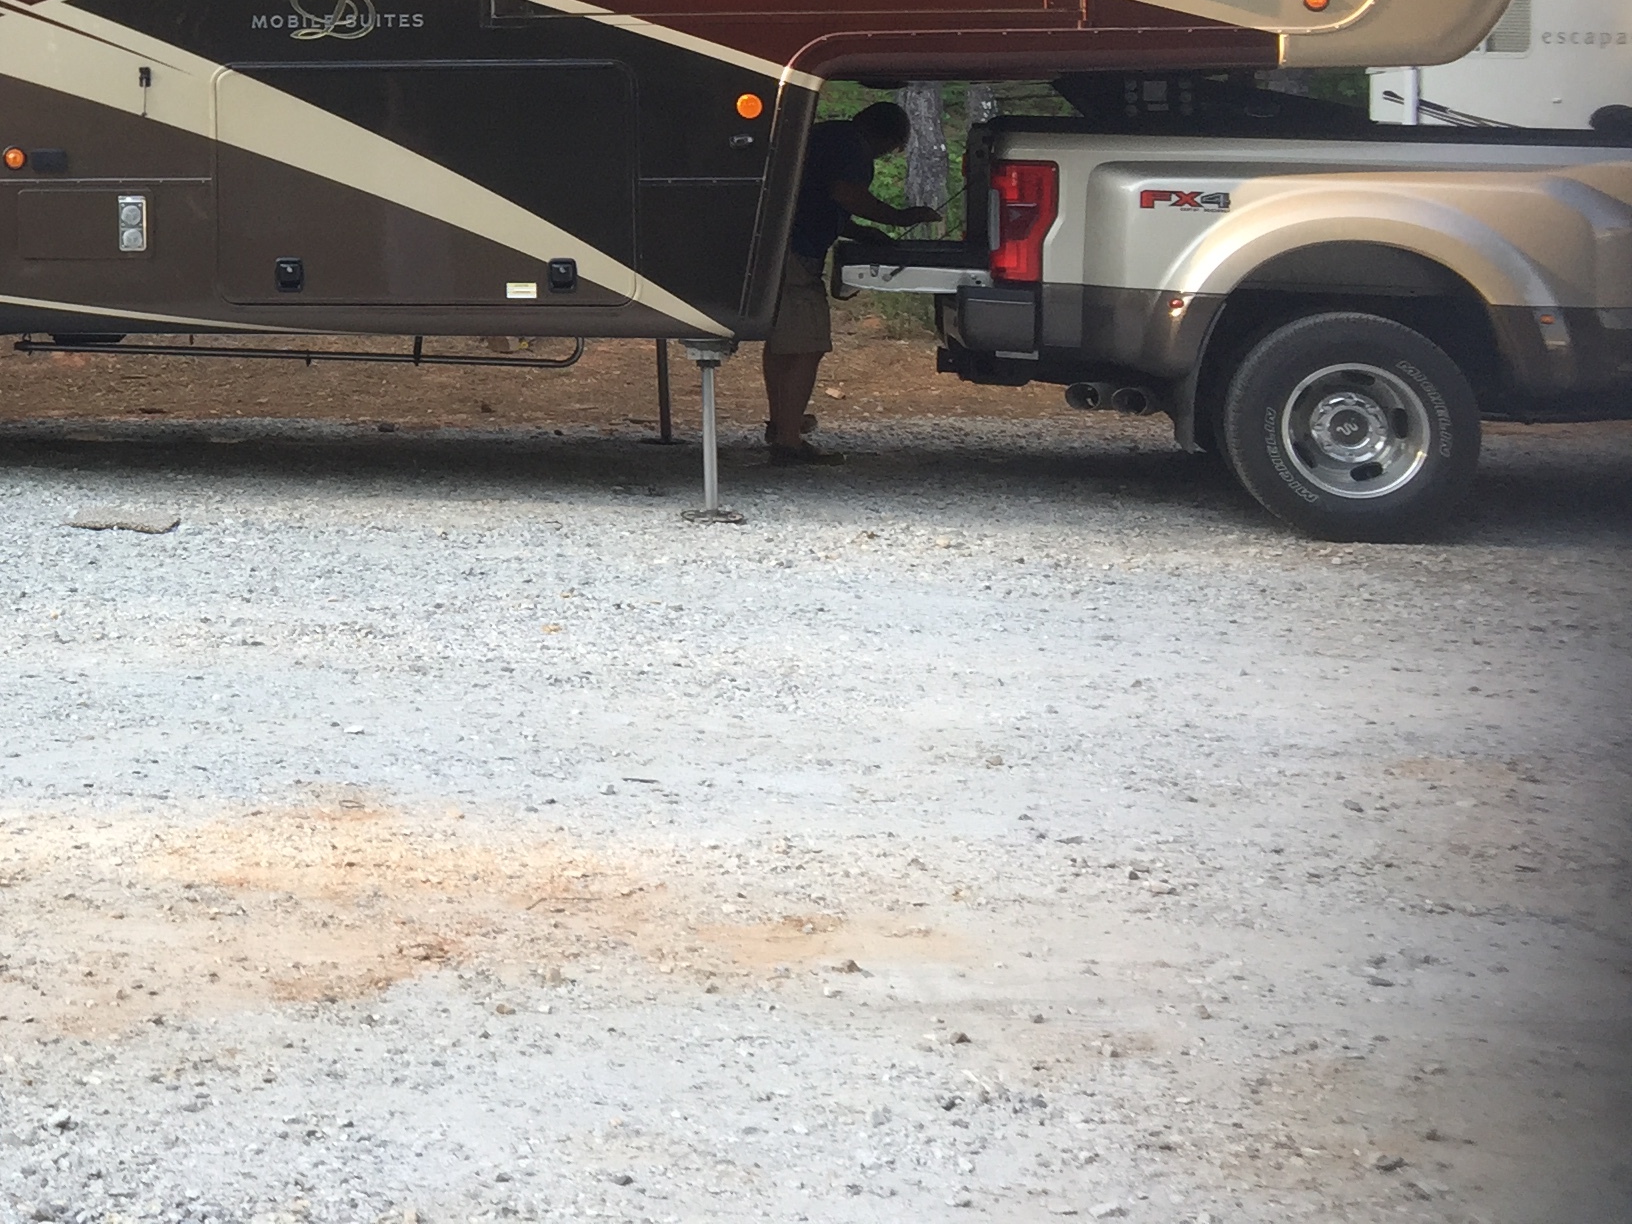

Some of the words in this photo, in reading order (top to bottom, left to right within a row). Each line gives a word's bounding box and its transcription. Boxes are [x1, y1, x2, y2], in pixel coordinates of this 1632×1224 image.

[251, 14, 336, 29] MOBILE
[345, 13, 425, 28] SUITES
[1541, 31, 1632, 49] escapa
[1139, 189, 1231, 209] FX4
[1395, 360, 1453, 458] MICHELIN
[1263, 406, 1319, 503] MICHELIN
